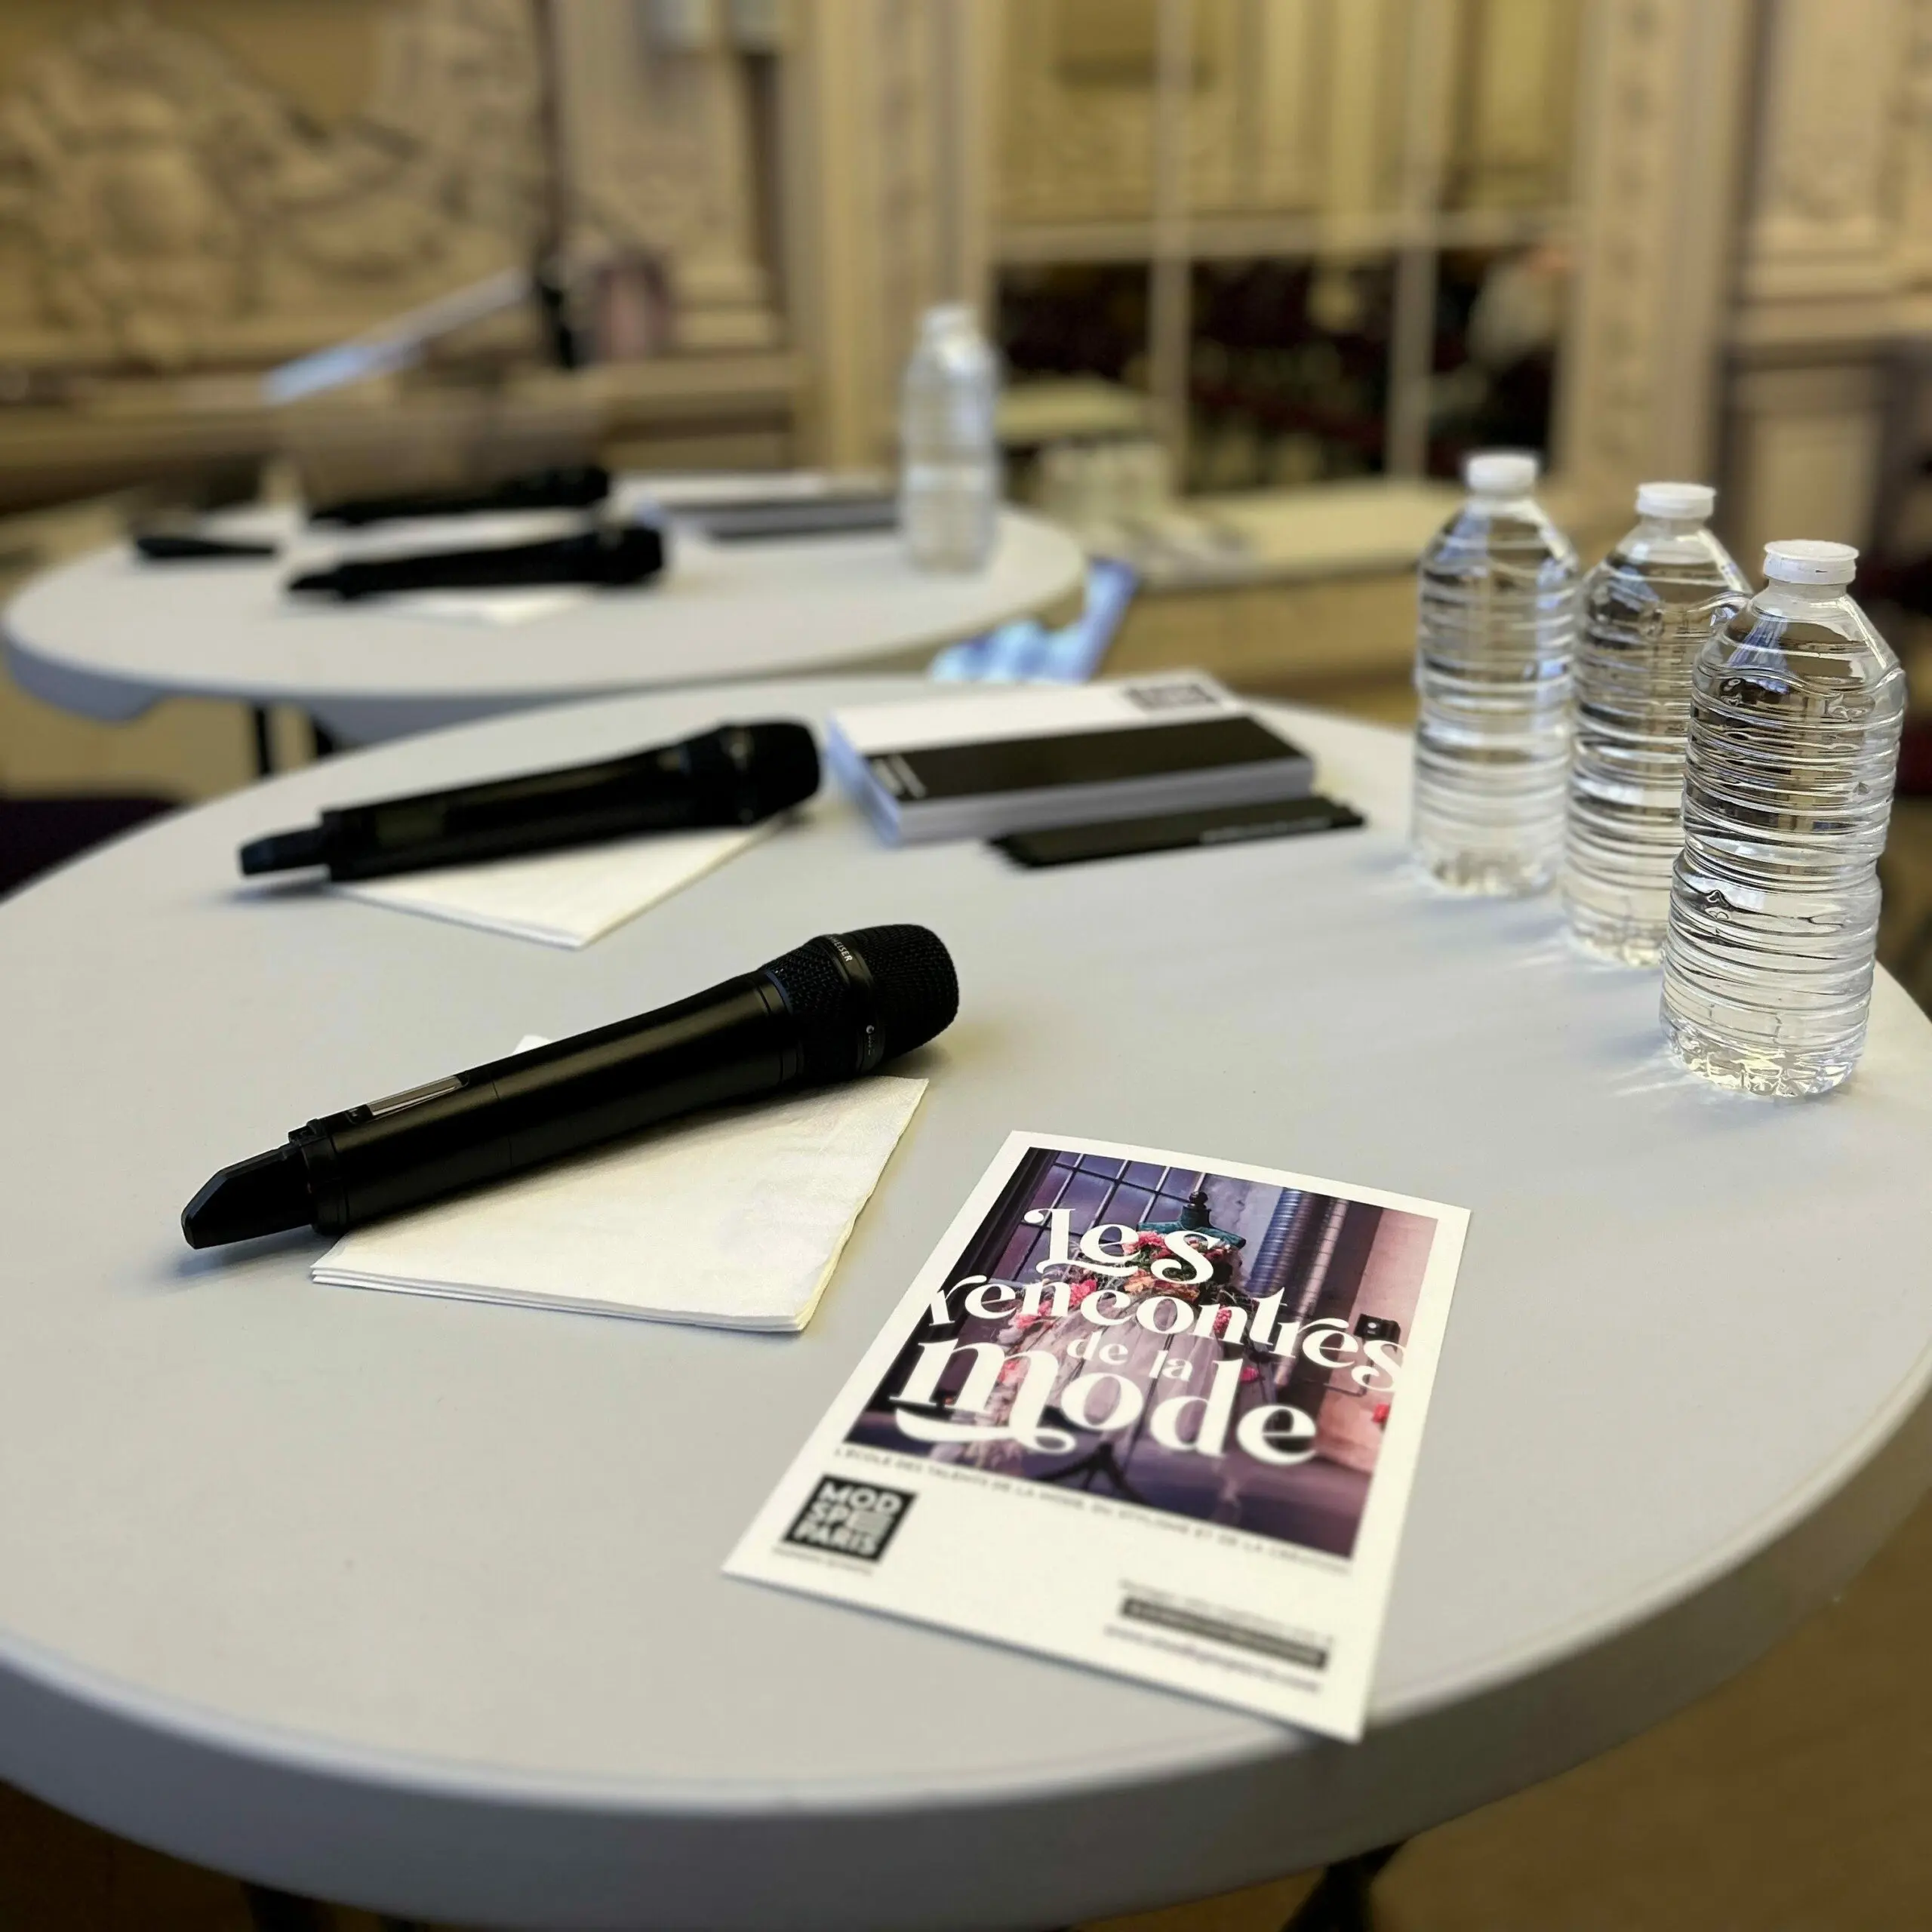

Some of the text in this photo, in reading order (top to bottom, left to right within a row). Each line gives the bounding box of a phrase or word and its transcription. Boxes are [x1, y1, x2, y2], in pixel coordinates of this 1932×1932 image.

[1023, 1208, 1221, 1284] Les
[928, 1274, 1407, 1392] rencontres
[1066, 1332, 1194, 1383] de la
[819, 1481, 903, 1517] MOD
[794, 1519, 876, 1556] PARIS
